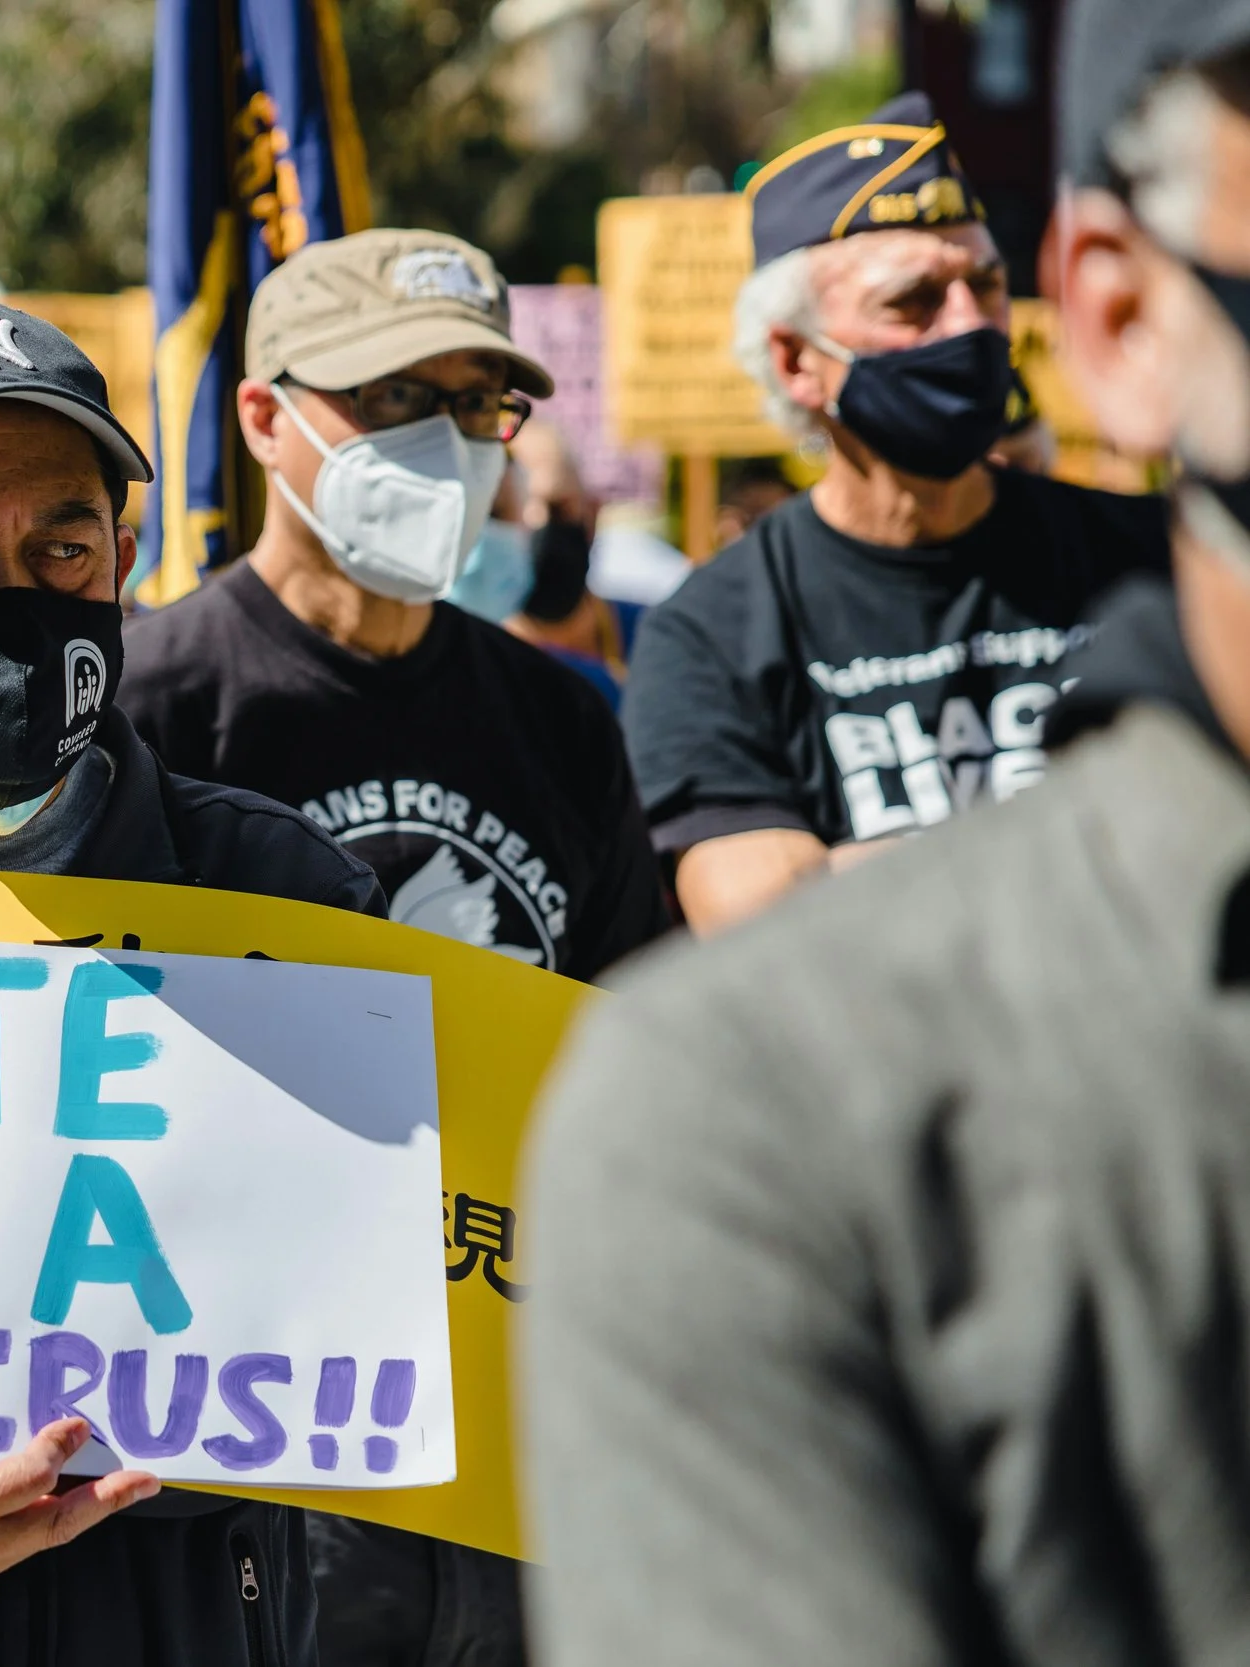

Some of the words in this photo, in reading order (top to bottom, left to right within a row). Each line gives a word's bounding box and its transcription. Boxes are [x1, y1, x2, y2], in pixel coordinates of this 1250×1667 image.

[58, 719, 97, 753] COVERED
[824, 682, 1082, 777] BLAC
[392, 779, 471, 832] FOR
[30, 1153, 193, 1335] A
